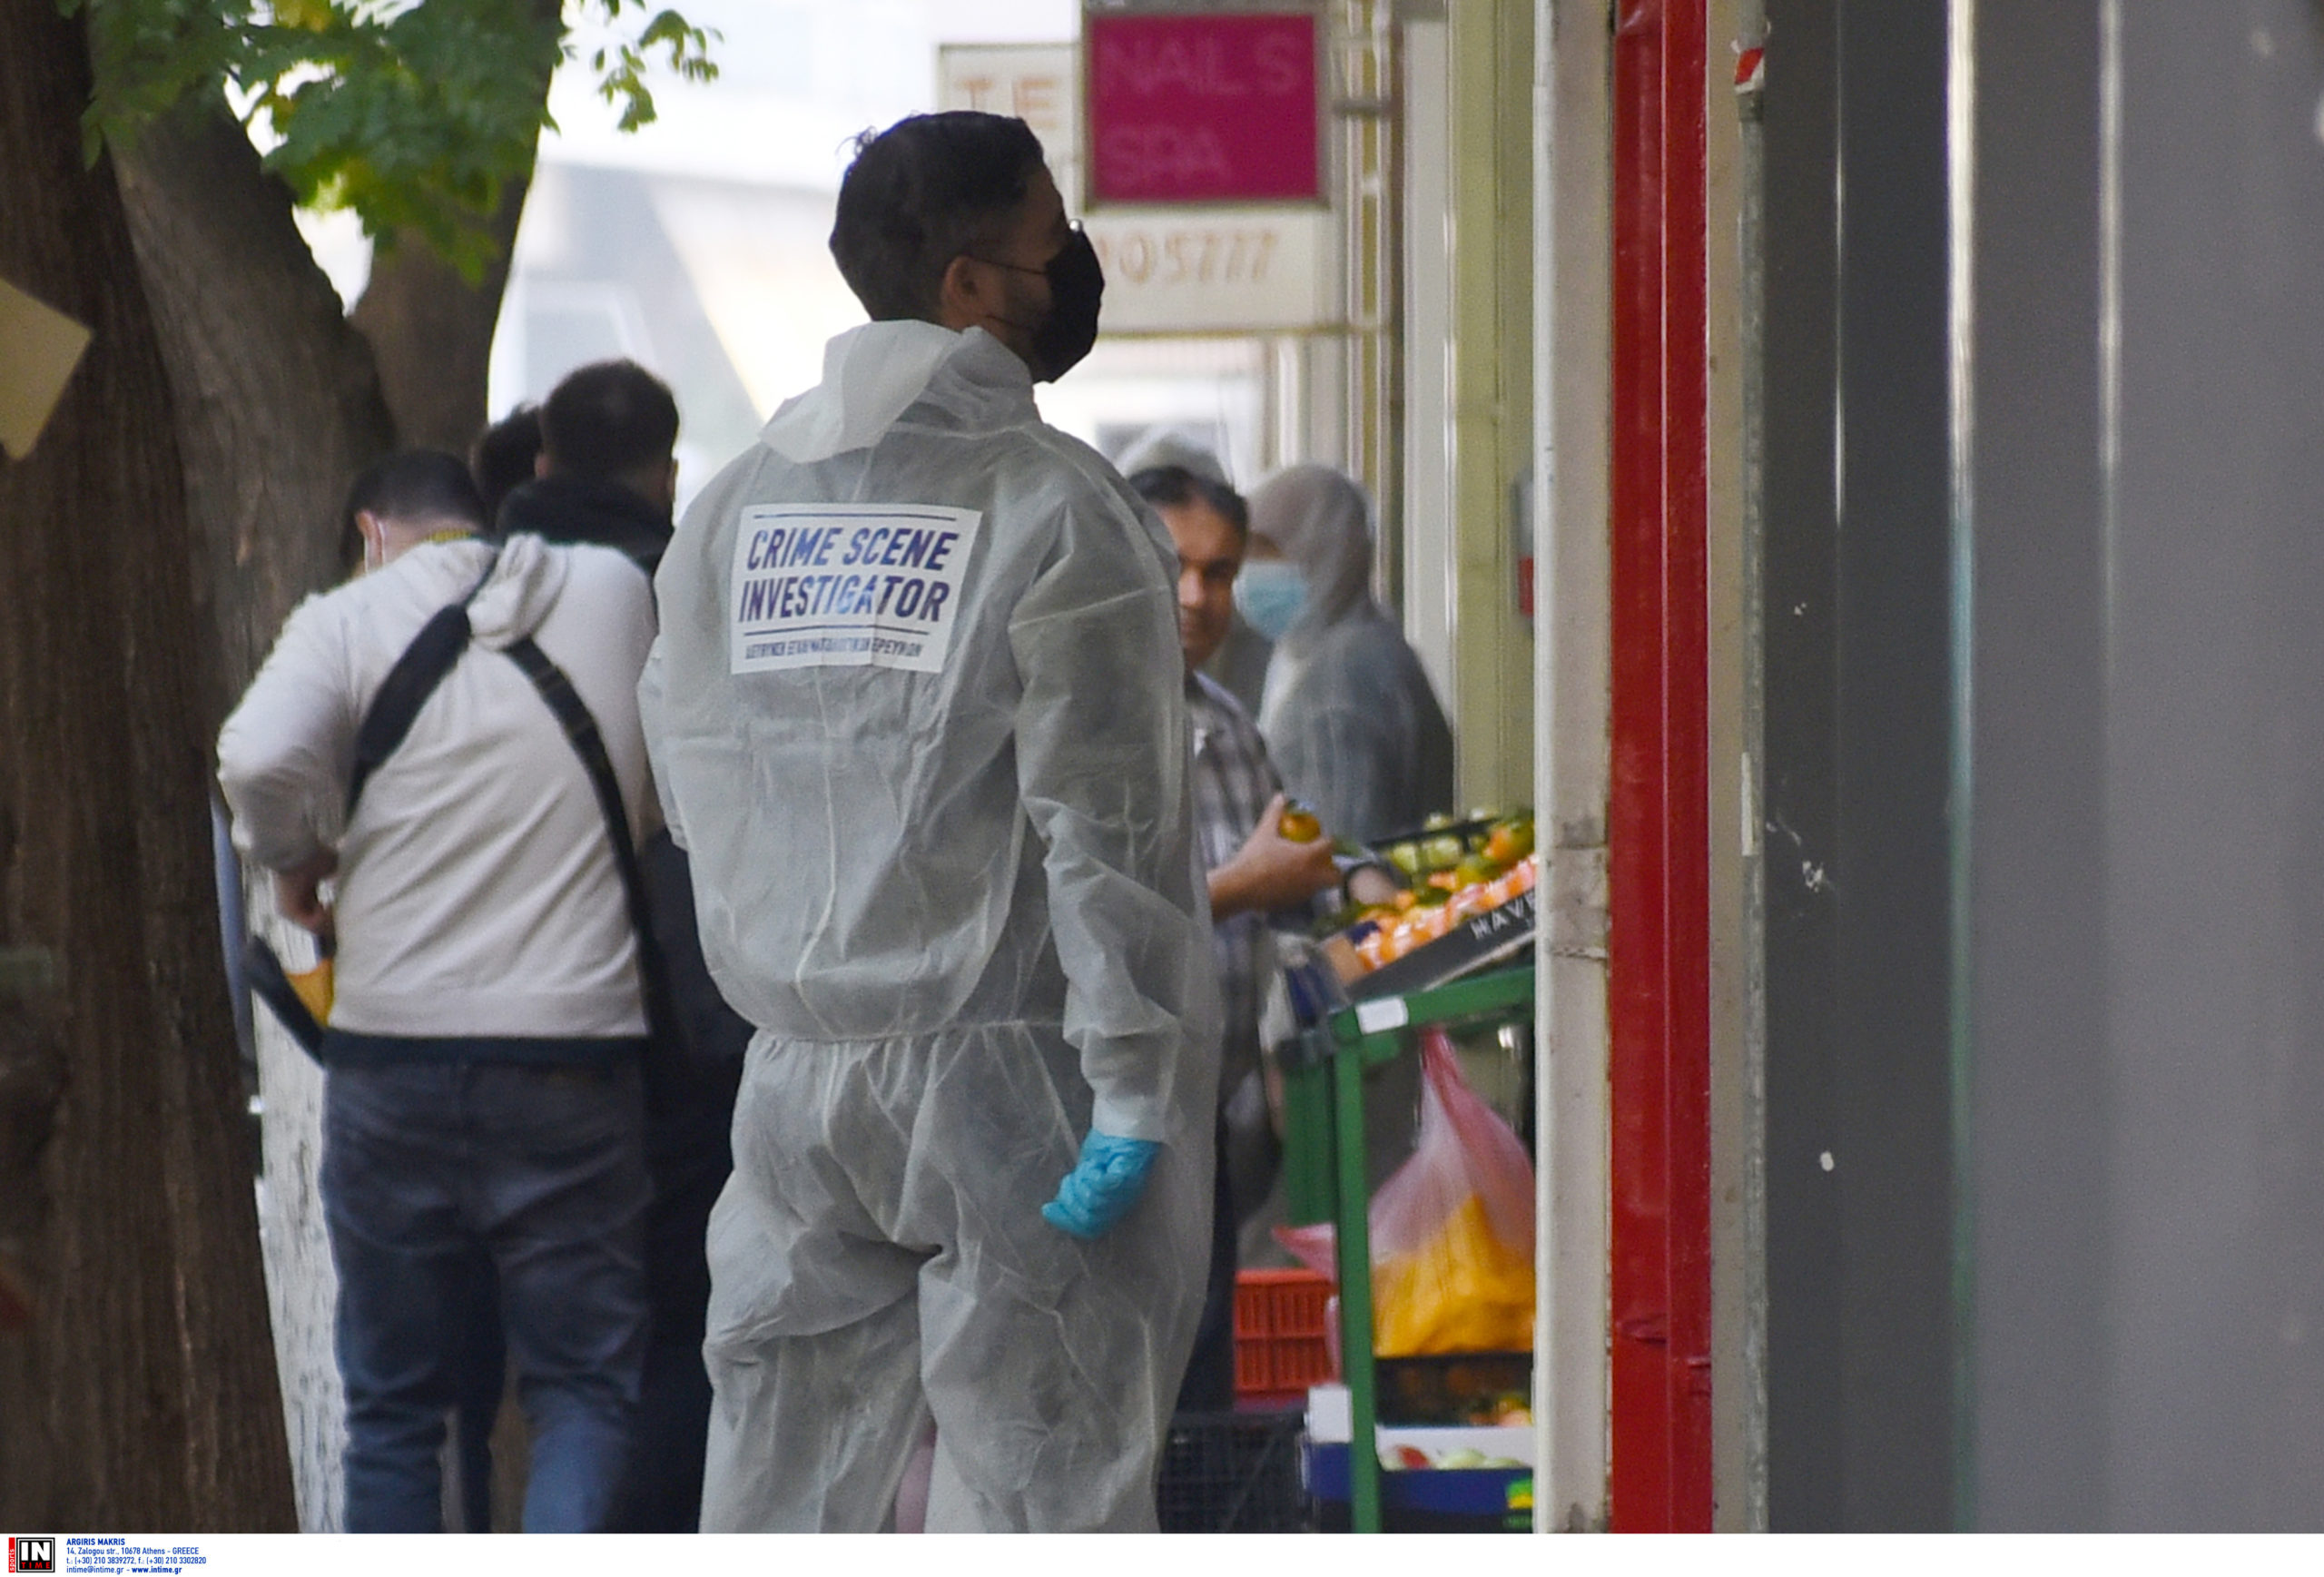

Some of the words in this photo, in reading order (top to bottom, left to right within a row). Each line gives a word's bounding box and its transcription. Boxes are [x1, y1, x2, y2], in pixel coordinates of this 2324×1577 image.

[1100, 124, 1233, 186] SPA
[746, 527, 842, 571] CRIME
[842, 527, 960, 571] SCENE
[738, 575, 950, 623] INVESTIGATOR
